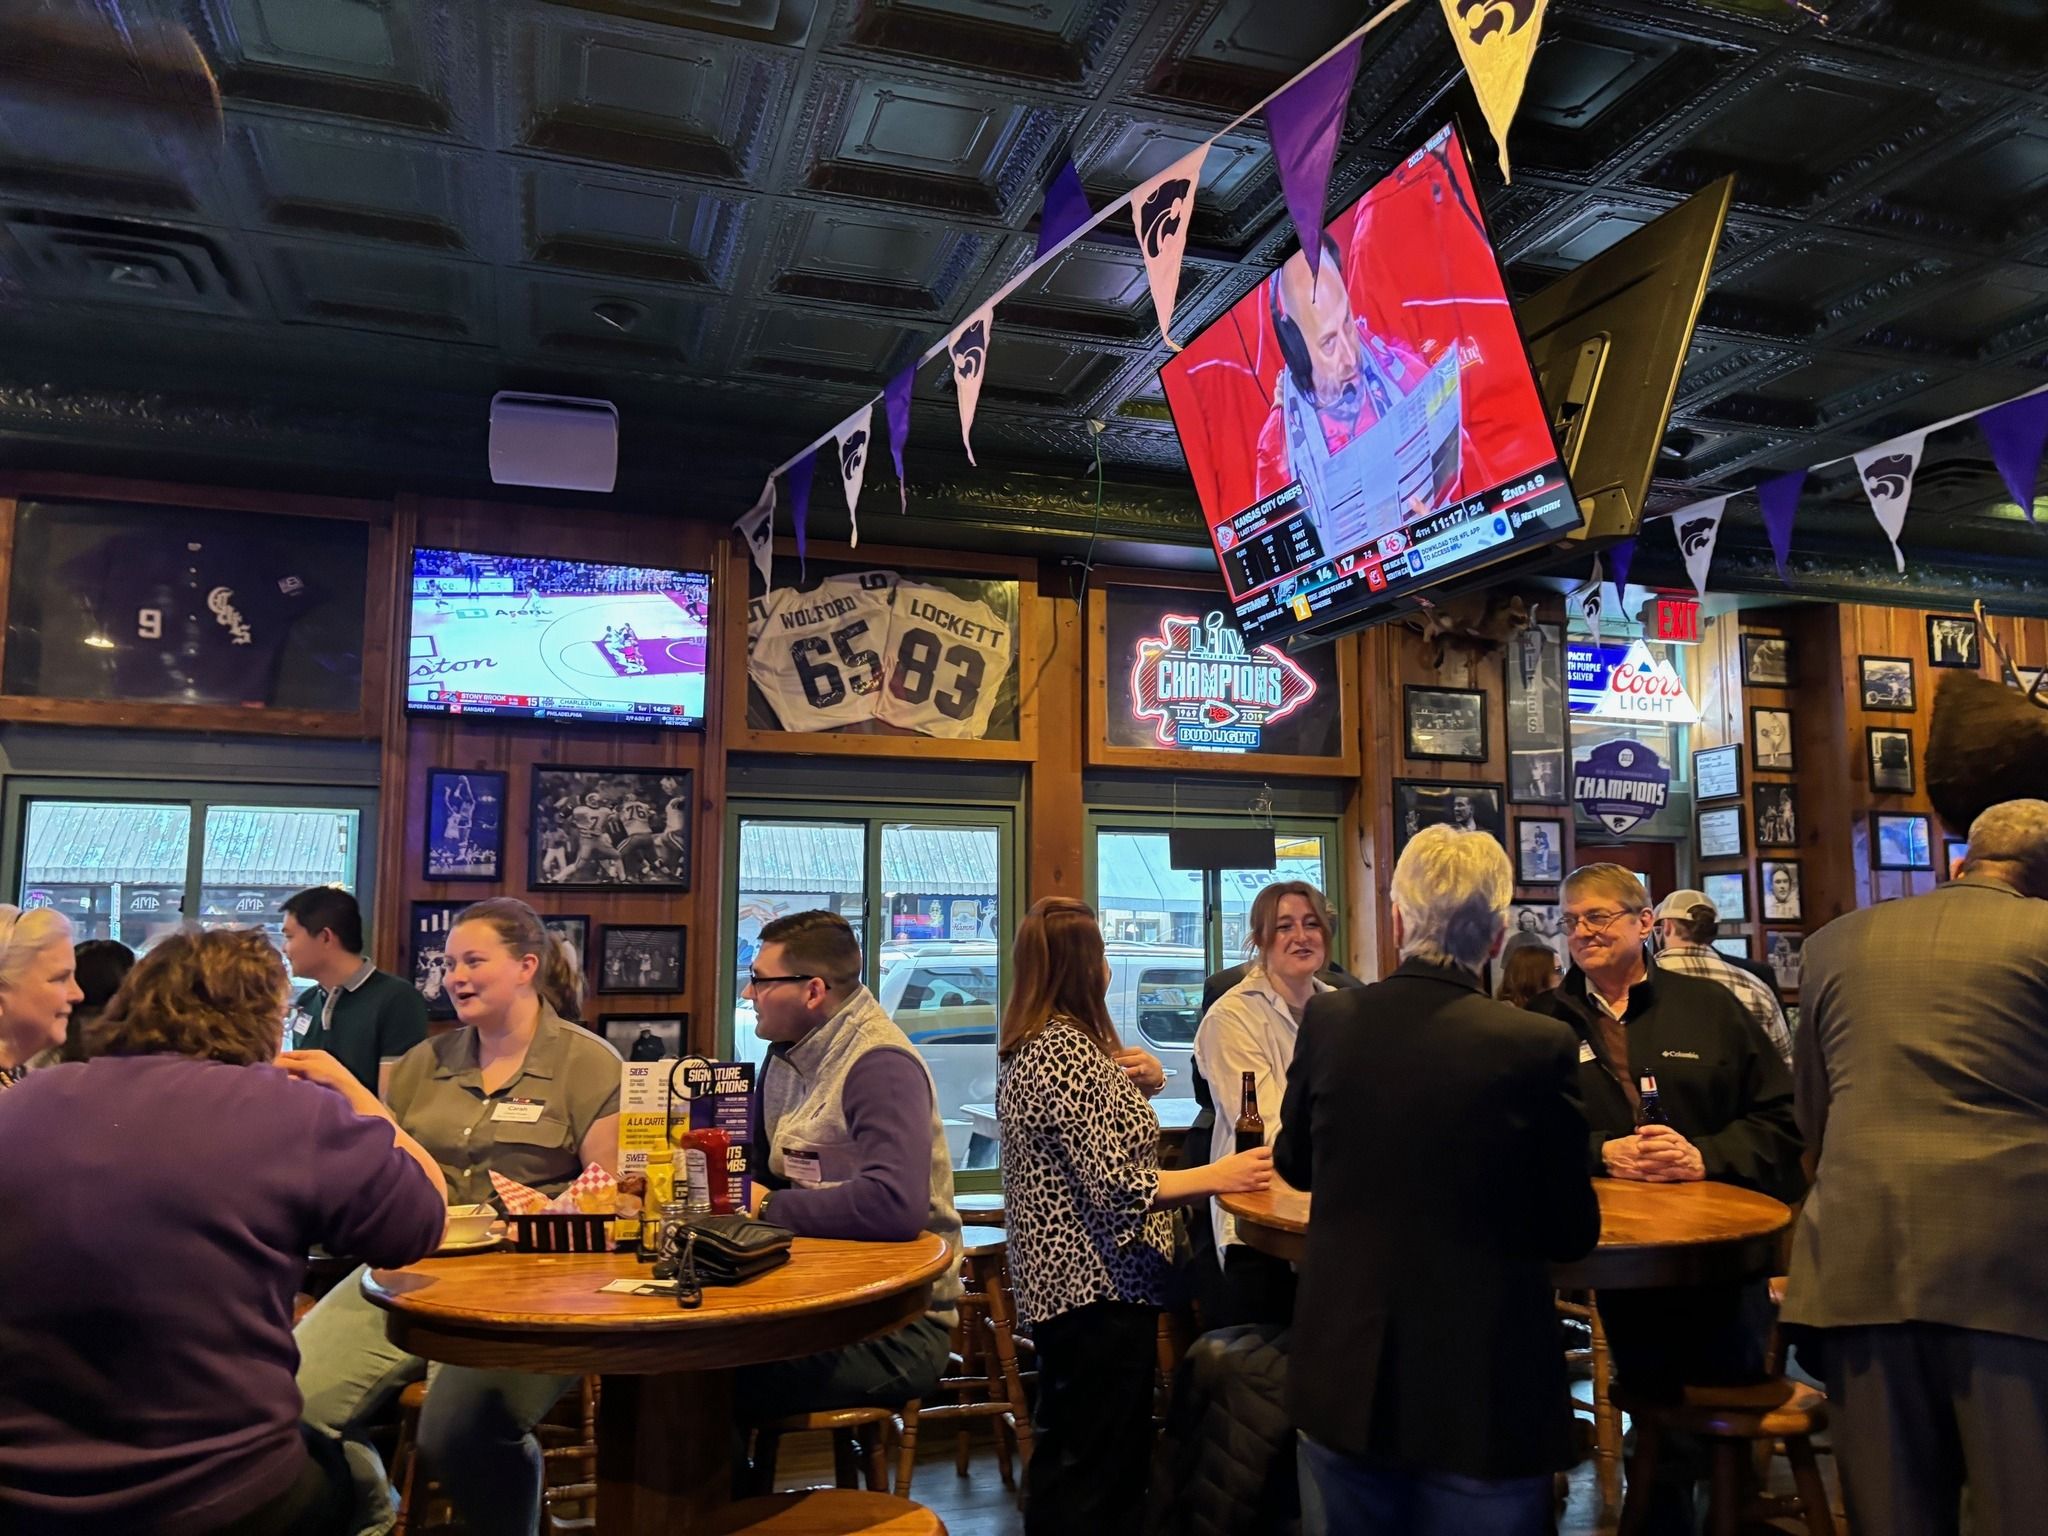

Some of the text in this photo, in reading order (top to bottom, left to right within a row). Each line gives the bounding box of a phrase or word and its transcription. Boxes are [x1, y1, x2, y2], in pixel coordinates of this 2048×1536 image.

[1501, 474, 1545, 502] 2ND & 9
[1234, 484, 1303, 529] KANSAS CITY CHIEFS
[1415, 501, 1485, 538] 4TH 11:17 24
[1292, 529, 1306, 541] PUNT
[1421, 526, 1481, 555] DOWNLOAD THE NFL APP
[1295, 539, 1309, 551] PUNT
[1295, 547, 1316, 563] FUMBLE
[1423, 553, 1431, 563] TO
[1431, 548, 1450, 560] ACCESS
[1340, 555, 1355, 572] 17
[1316, 566, 1333, 582] 14
[780, 595, 857, 630] WOLFORD
[1657, 600, 1700, 640] EXIT
[138, 608, 162, 639] 9
[910, 598, 1005, 649] LOCKETT
[789, 619, 884, 709] 65
[1568, 651, 1593, 662] PACK IT
[888, 627, 986, 721] 83
[1577, 662, 1601, 673] PURPLE
[1158, 660, 1282, 707] CHAMPIONS
[1572, 672, 1594, 682] SILVER
[1611, 663, 1682, 697] Coors
[483, 694, 506, 702] BROOK
[526, 697, 538, 706] 15
[560, 699, 602, 708] CHARLESTON
[628, 703, 635, 712] 2
[653, 705, 671, 713] 14:22
[1620, 695, 1673, 713] LIGHT
[546, 710, 583, 719] PHILADELPHIA
[1177, 709, 1197, 718] 1969
[1241, 712, 1263, 721] 2019
[1181, 728, 1257, 744] BUD LIGHT
[1574, 776, 1666, 806] CHAMPIONS
[626, 804, 647, 821] 76
[236, 896, 265, 910] AMP
[629, 1068, 649, 1076] SIDES
[700, 1080, 749, 1095] LIATIONS
[627, 1118, 633, 1127] A
[634, 1117, 644, 1126] LA
[644, 1117, 666, 1126] CARTE
